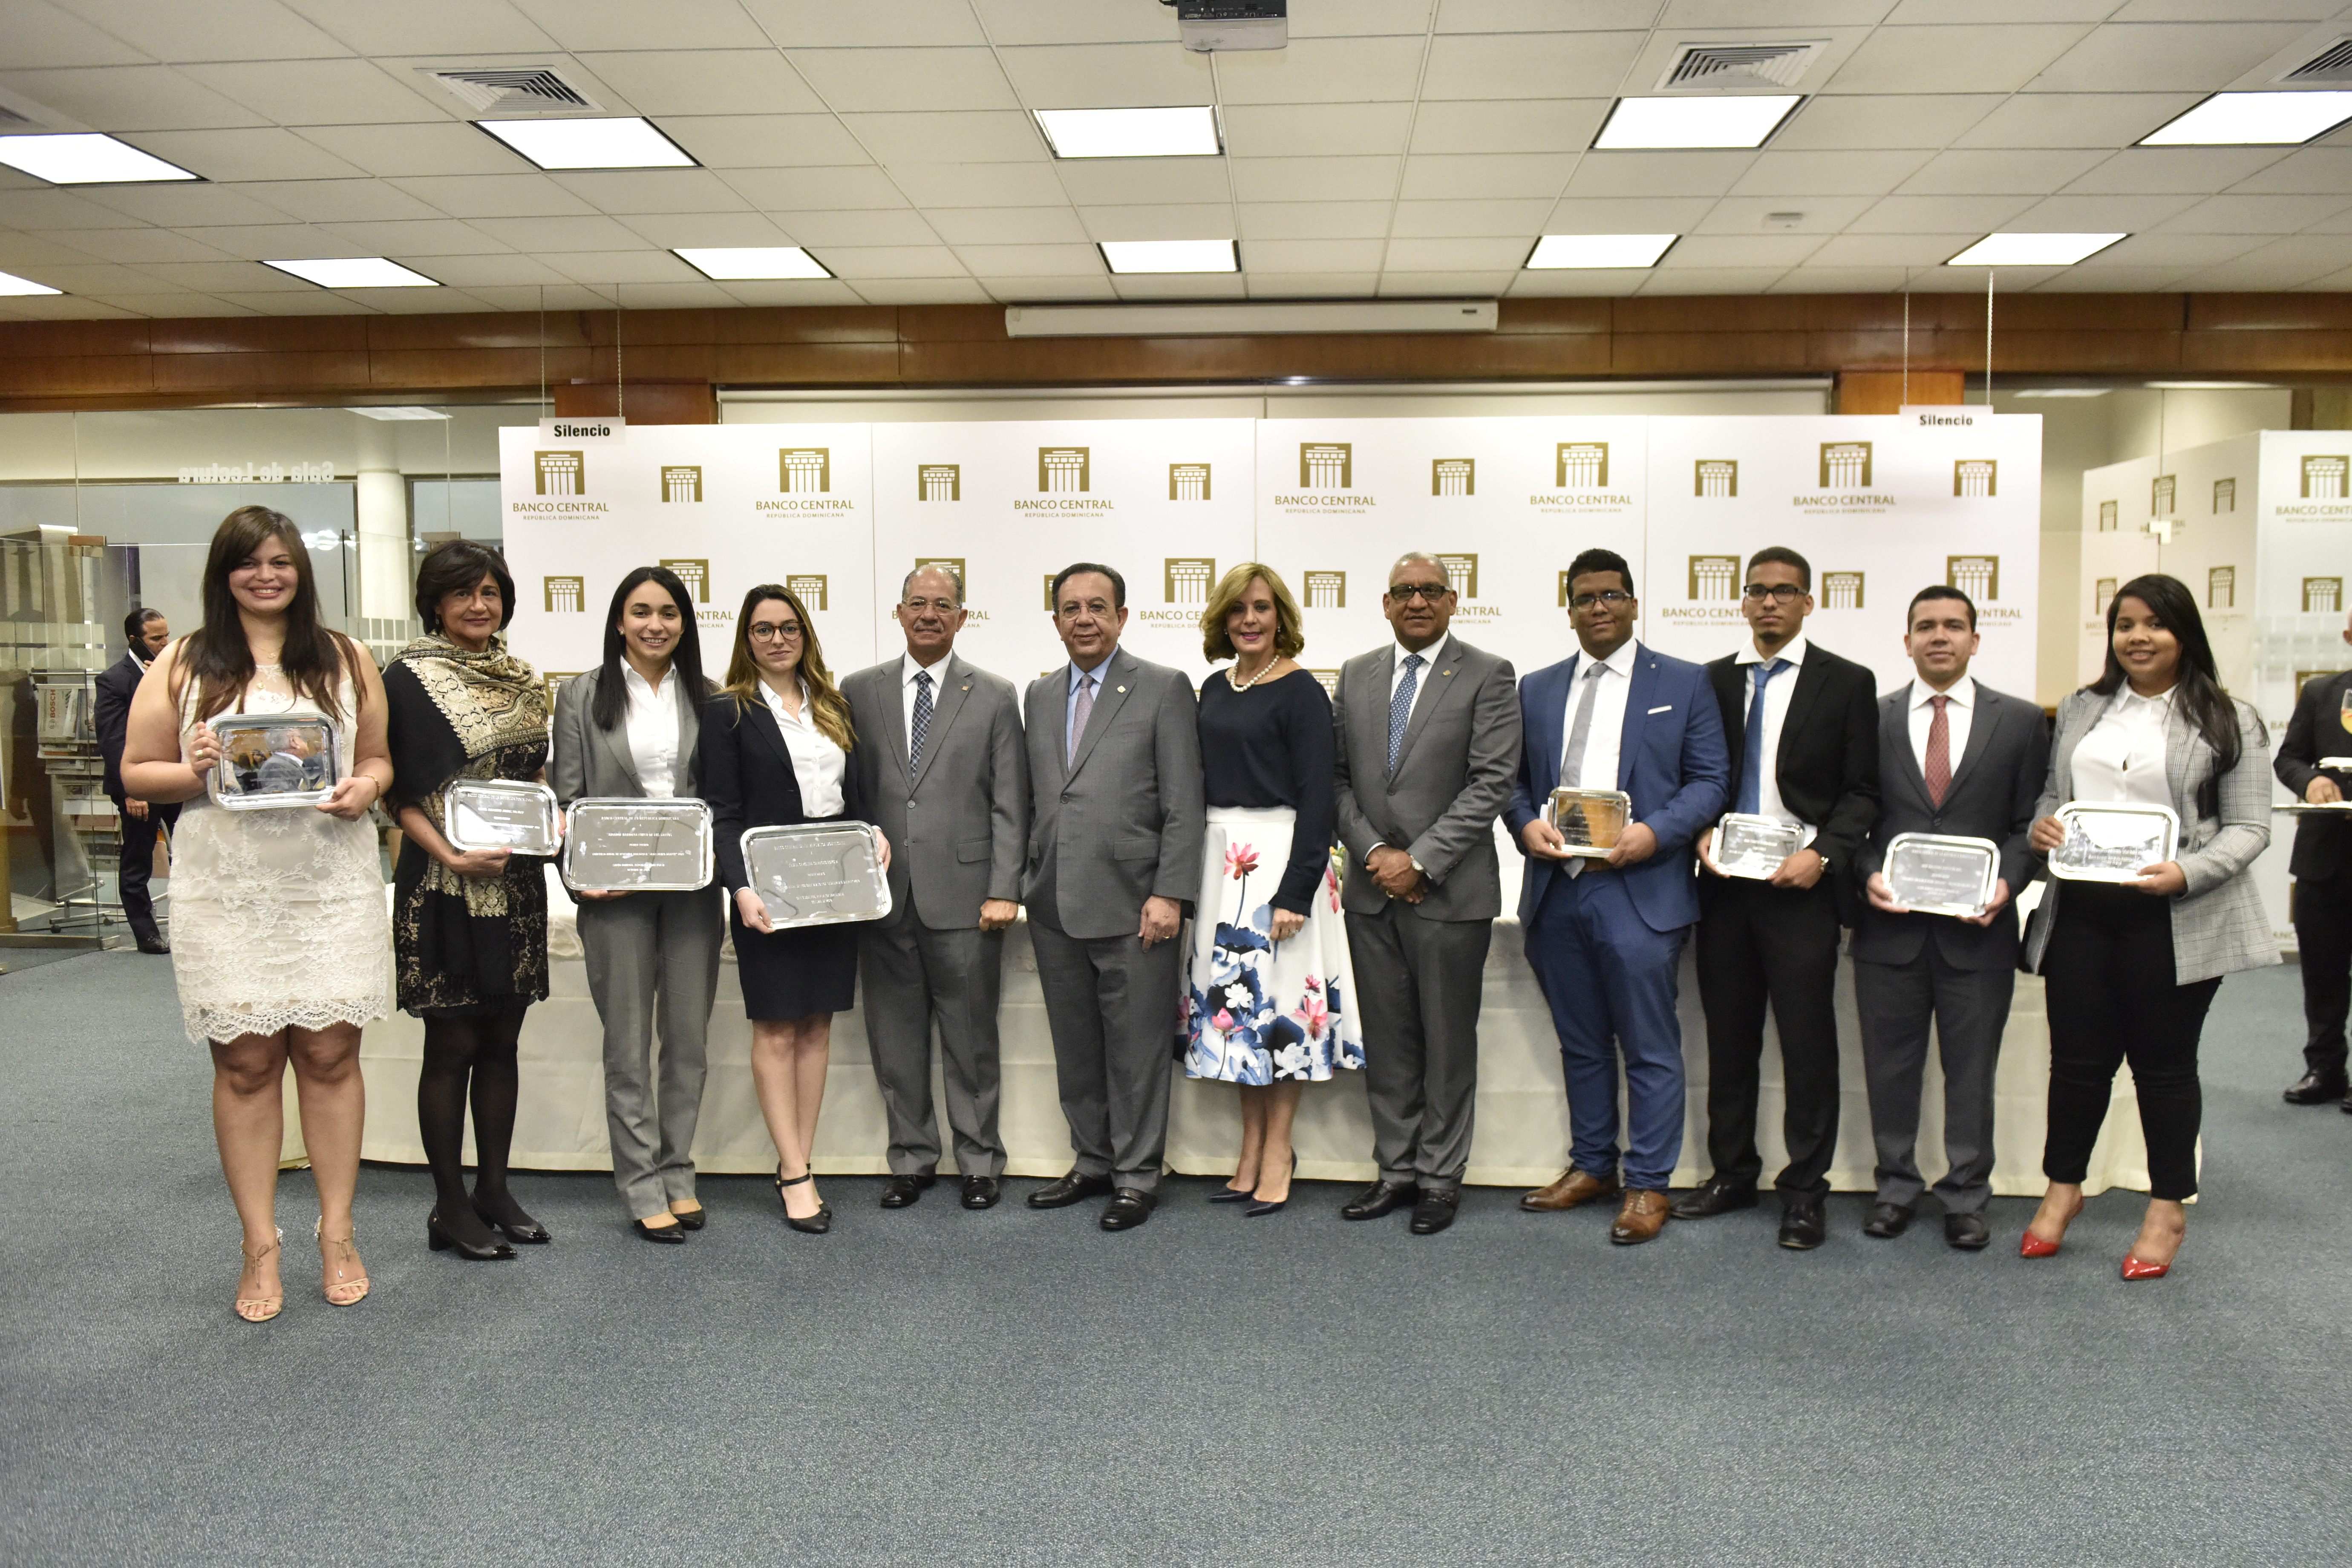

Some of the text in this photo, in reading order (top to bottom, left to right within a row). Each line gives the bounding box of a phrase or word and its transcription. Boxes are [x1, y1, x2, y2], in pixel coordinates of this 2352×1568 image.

[1920, 414, 1973, 425] Silencio
[554, 424, 610, 437] Silencio
[756, 500, 854, 510] BANCO CENTRAL
[1015, 500, 1114, 509] BANCO CENTRAL
[1275, 496, 1376, 506] BANCO CENTRAL
[1530, 495, 1632, 505] BANCO CENTRAL
[1793, 495, 1897, 506] BANCO CENTRAL
[513, 503, 609, 512] BANCO CENTRAL
[2276, 505, 2352, 516] BANCO CENT
[696, 611, 734, 620] NTRAL
[1140, 611, 1183, 620] BANCO
[1456, 607, 1502, 616] ENTRAL
[1663, 608, 1741, 617] BANCO CENT
[1977, 608, 2023, 619] ENTRAL
